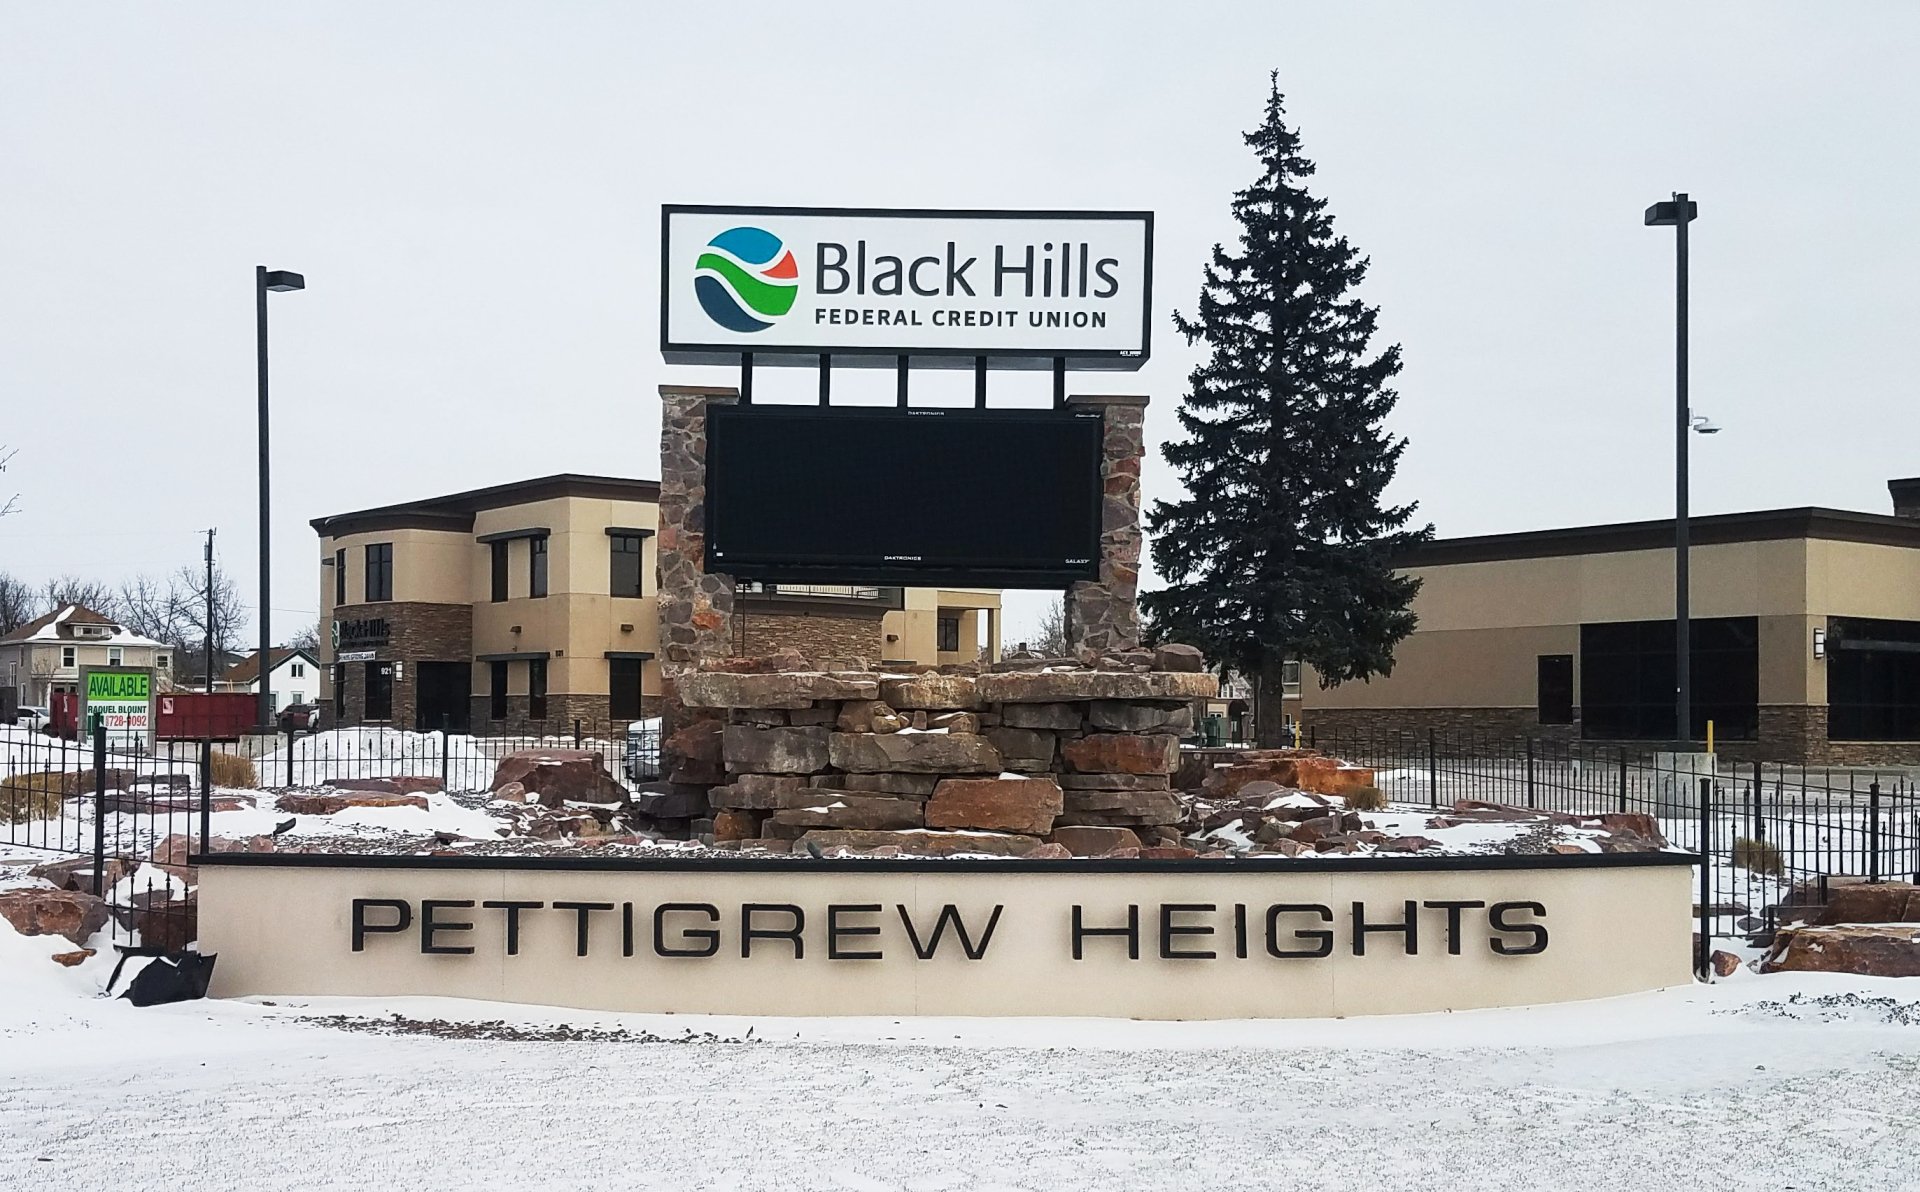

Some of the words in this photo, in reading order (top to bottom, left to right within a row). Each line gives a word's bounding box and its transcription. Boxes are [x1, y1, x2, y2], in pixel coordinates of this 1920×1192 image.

[816, 240, 977, 297] Black
[994, 242, 1120, 299] Hills
[815, 308, 923, 326] FEDERAL
[932, 309, 1019, 328] CREDIT
[1029, 311, 1106, 328] UNION
[381, 667, 391, 675] 921
[89, 676, 147, 696] AVAILABLE
[88, 705, 116, 713] RAQUEL
[118, 705, 146, 713] BLOUNT
[351, 898, 1004, 960] PETTIGREW
[1071, 900, 1549, 960] HEIGHTS
